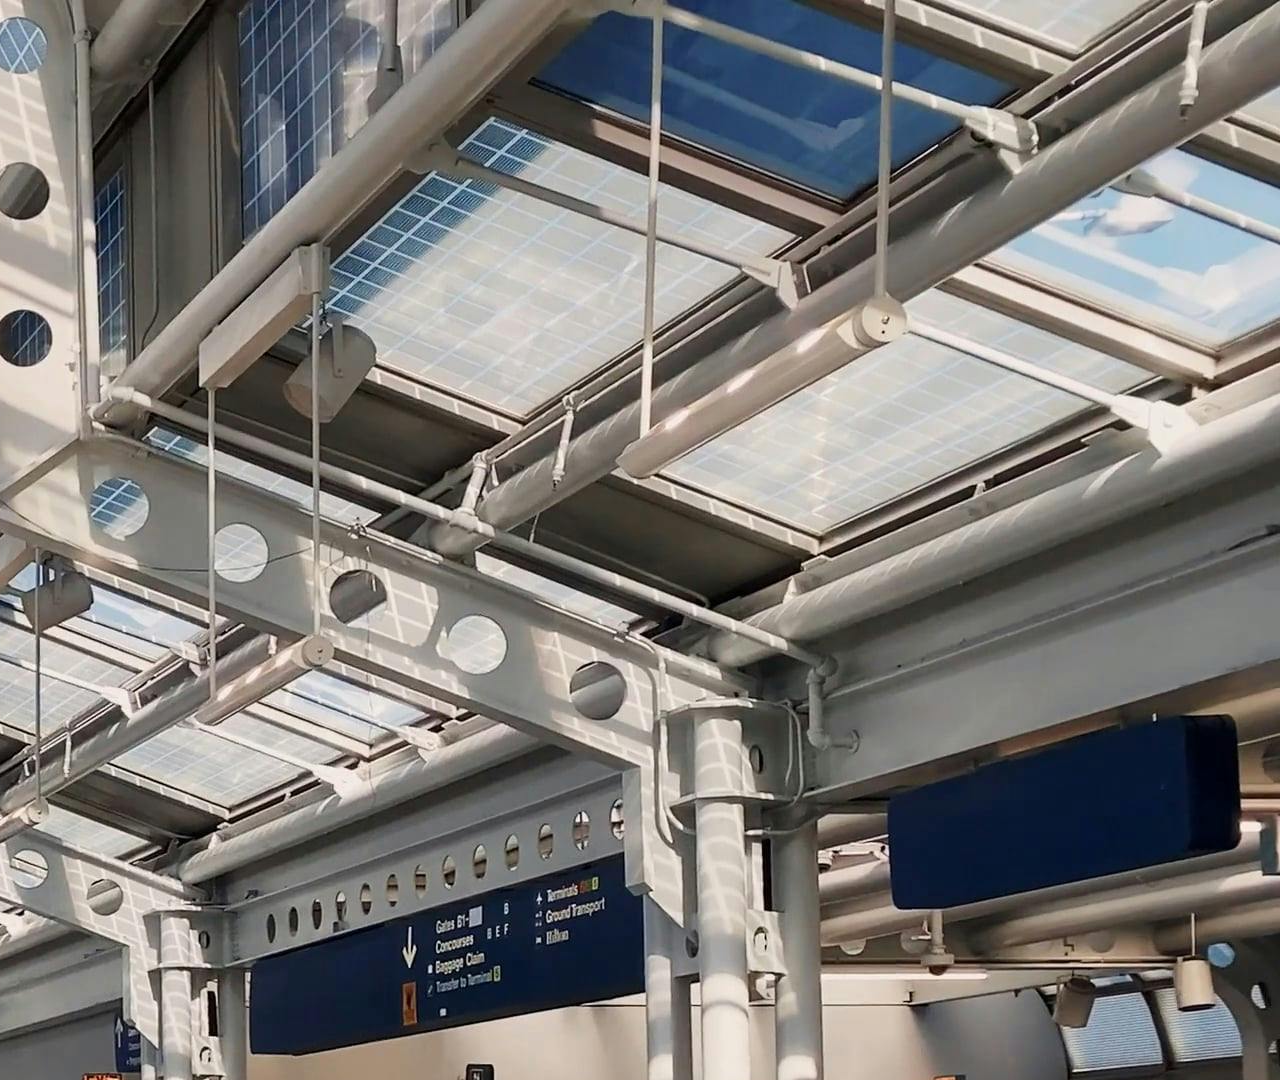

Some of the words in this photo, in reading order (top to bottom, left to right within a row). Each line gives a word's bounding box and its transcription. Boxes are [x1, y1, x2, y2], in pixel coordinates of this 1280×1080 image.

[546, 905, 571, 924] Ground
[571, 896, 605, 917] Transport
[436, 934, 474, 954] Concourses
[503, 923, 509, 936] F
[435, 957, 464, 975] Baggage
[465, 950, 485, 967] Claim
